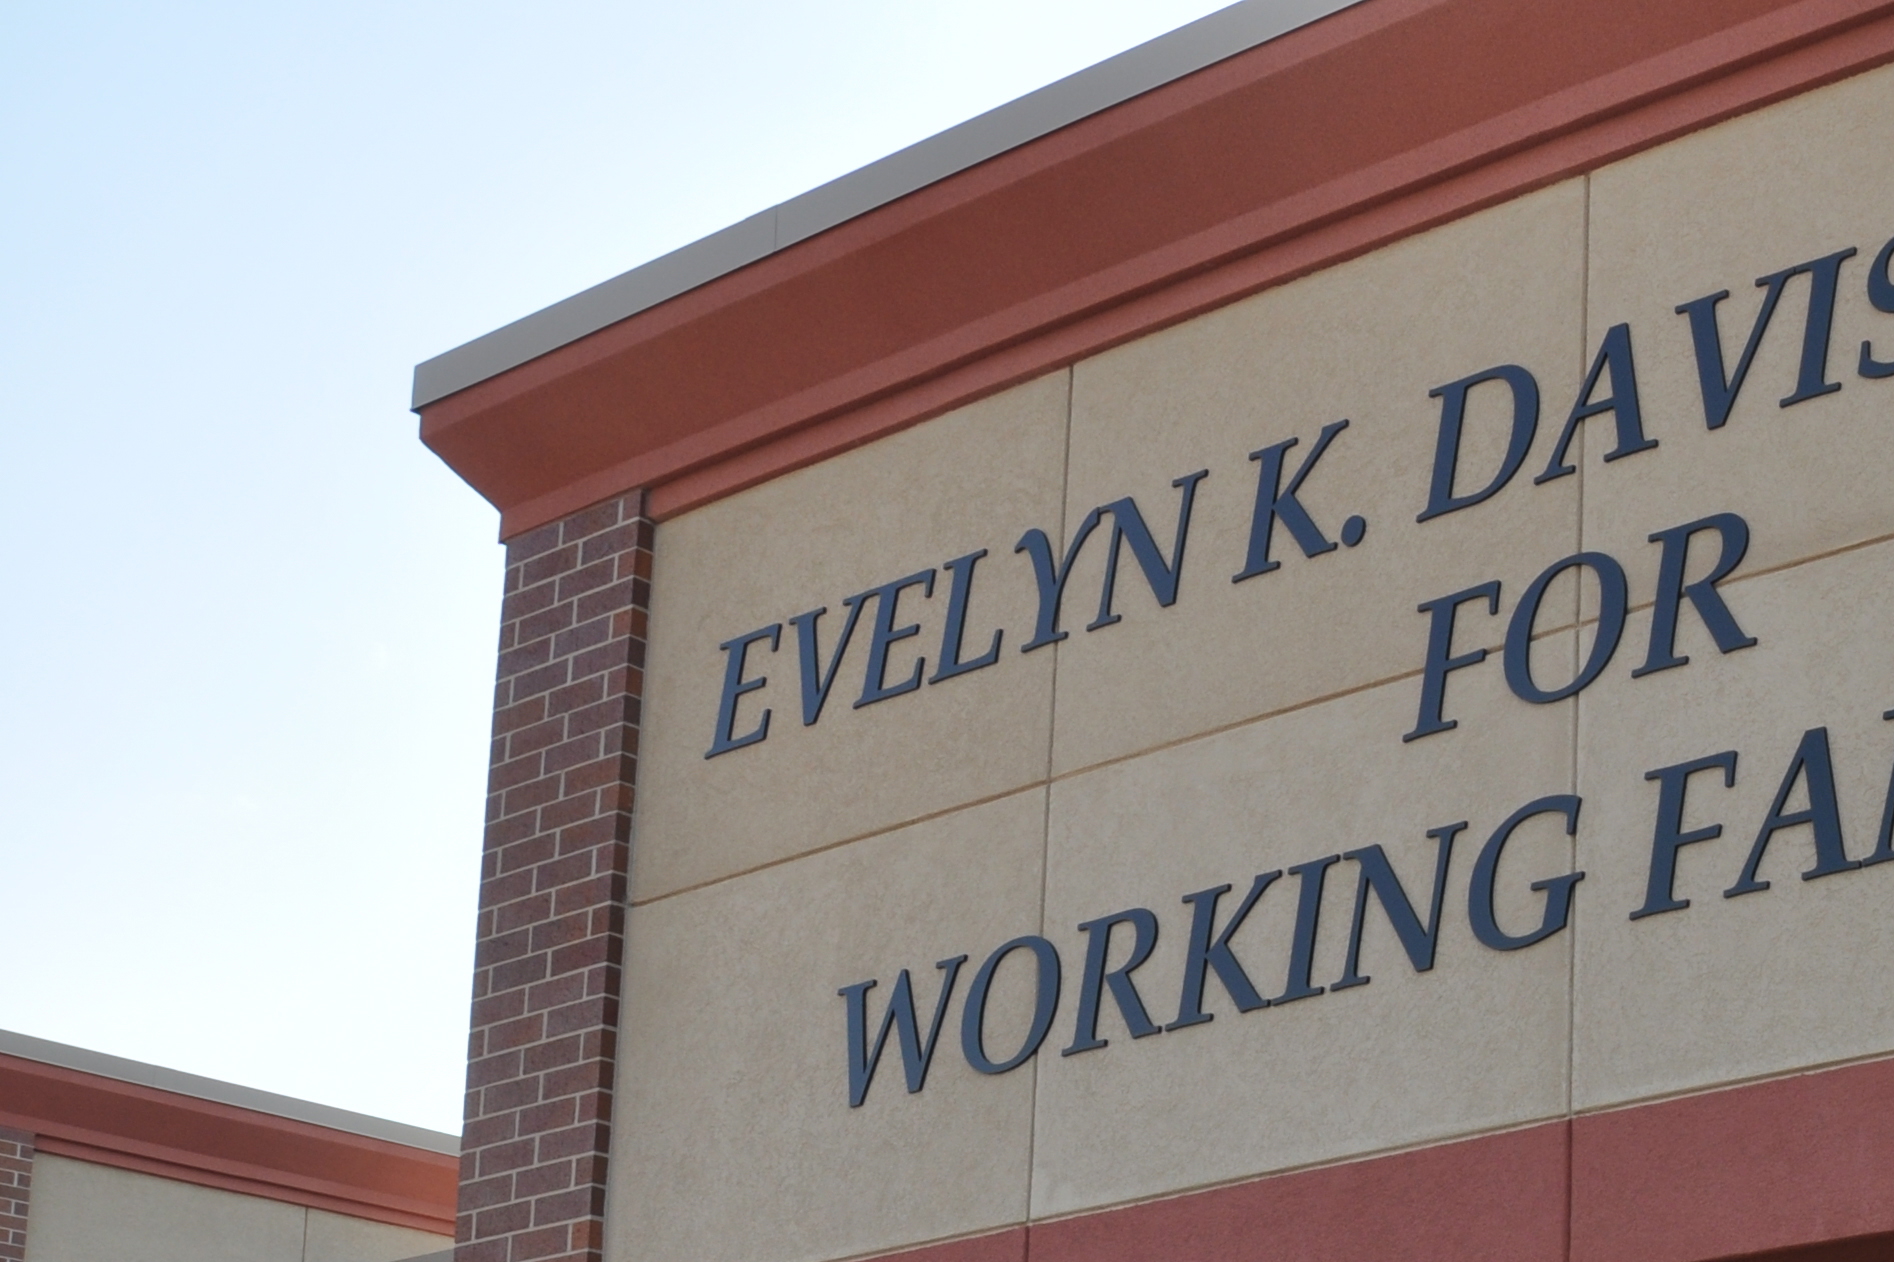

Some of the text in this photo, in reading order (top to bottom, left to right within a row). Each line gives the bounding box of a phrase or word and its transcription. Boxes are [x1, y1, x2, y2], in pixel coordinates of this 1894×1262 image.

[704, 468, 1210, 760] EVELYN
[1231, 419, 1368, 584] K.
[1403, 512, 1759, 744] FOR
[837, 793, 1587, 1109] WORKING
